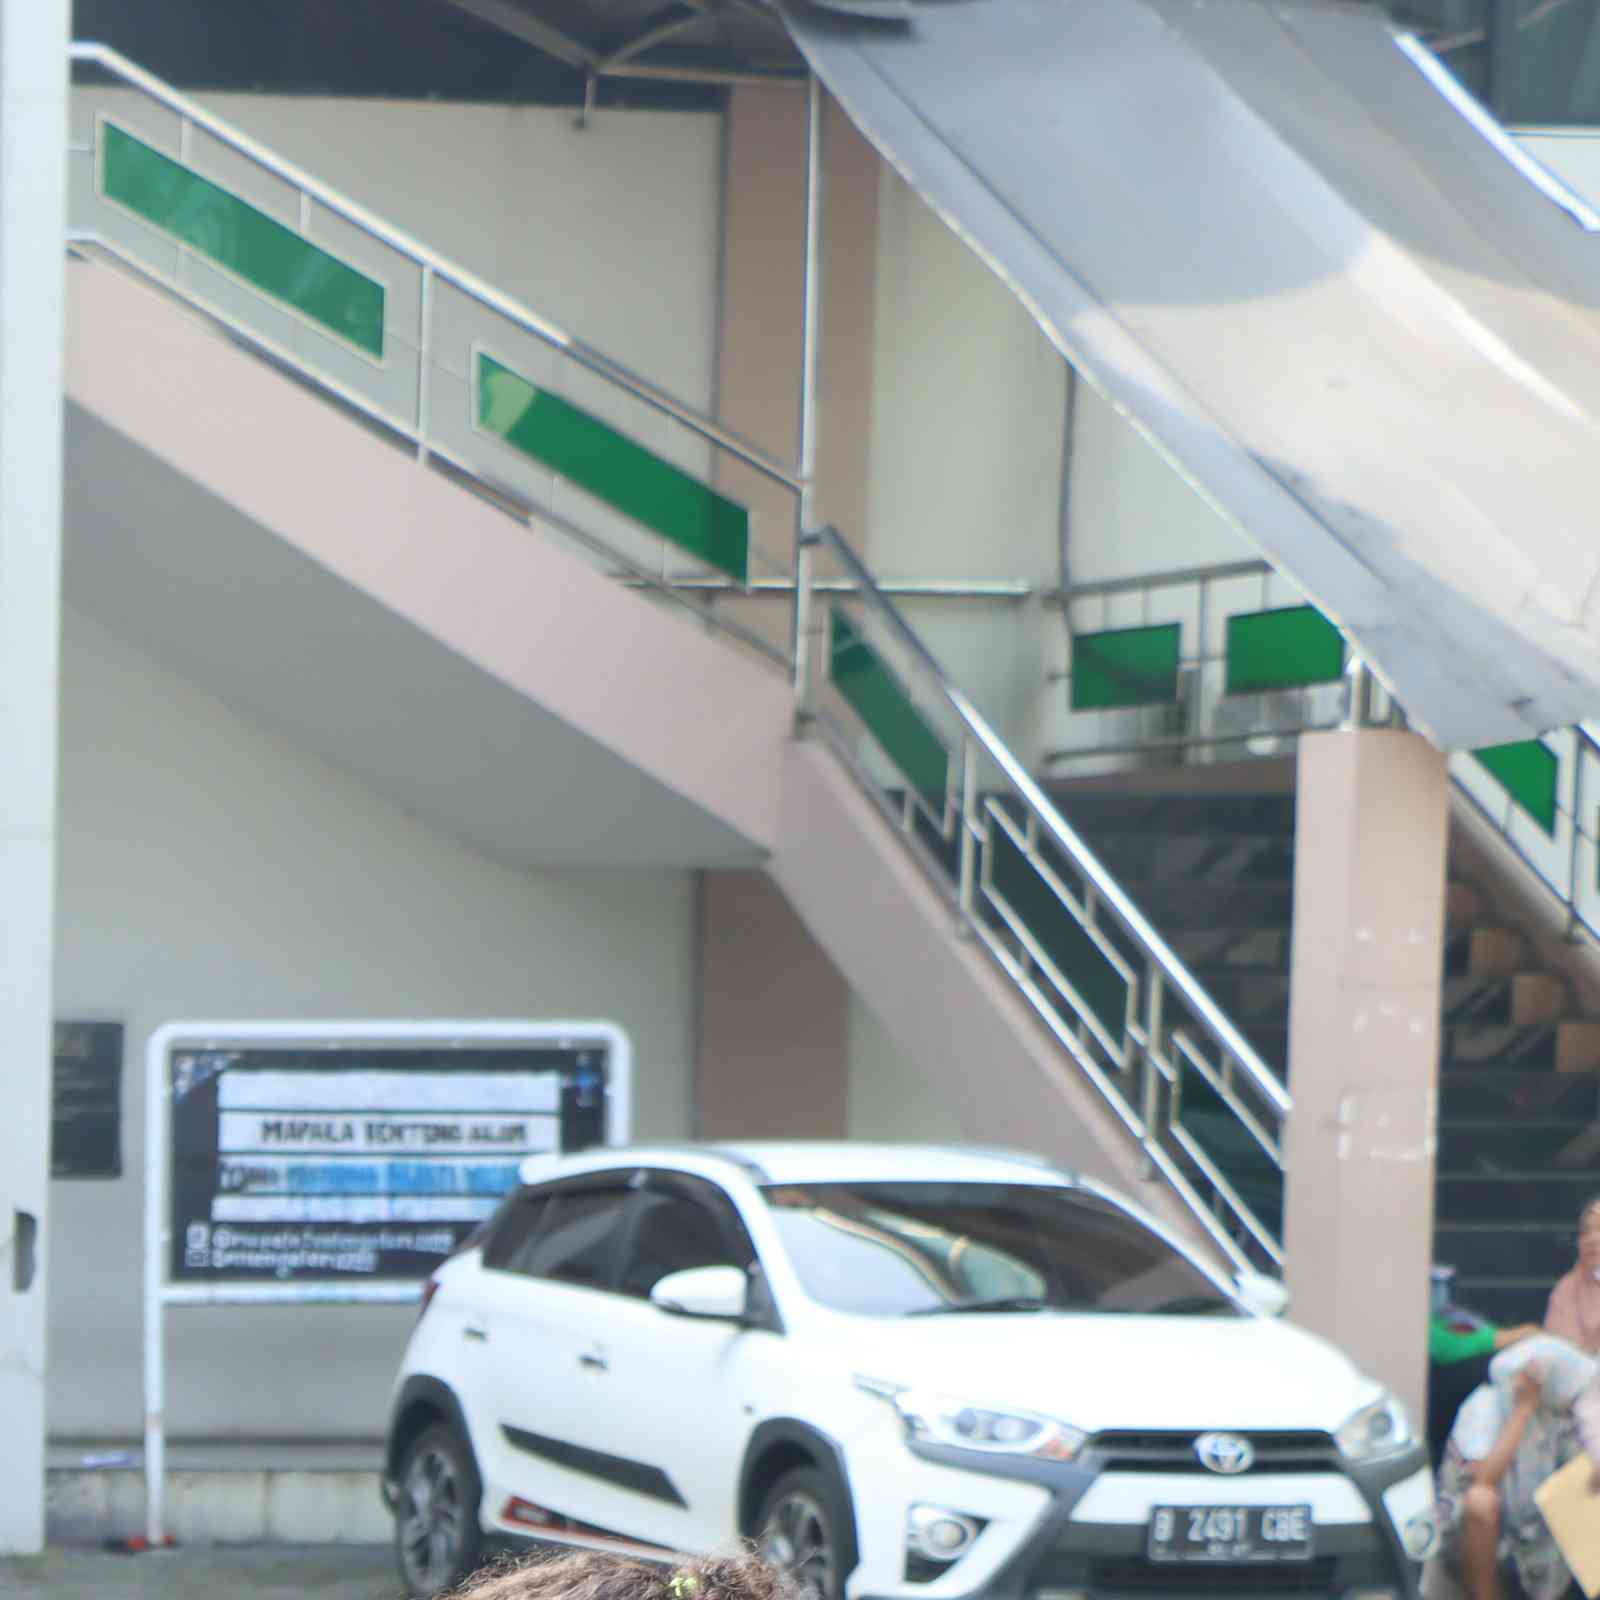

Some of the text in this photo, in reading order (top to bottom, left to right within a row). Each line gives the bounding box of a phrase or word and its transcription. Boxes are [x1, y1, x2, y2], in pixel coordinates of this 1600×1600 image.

[261, 1121, 353, 1143] MAPALA
[1153, 1506, 1174, 1542] B
[1187, 1507, 1248, 1542] 2491
